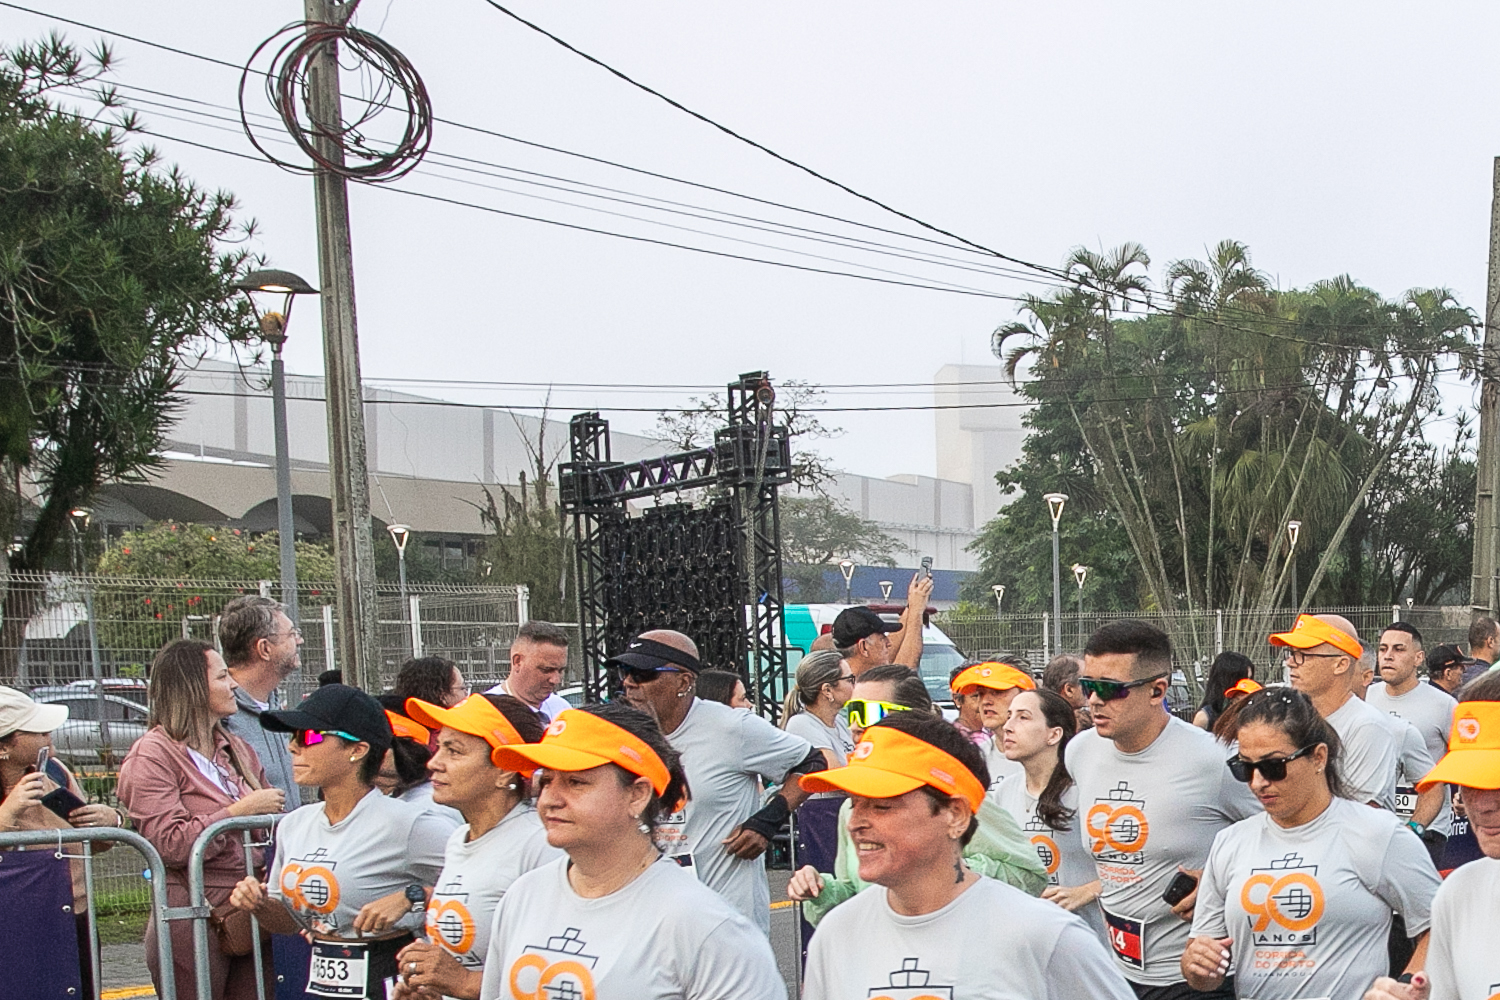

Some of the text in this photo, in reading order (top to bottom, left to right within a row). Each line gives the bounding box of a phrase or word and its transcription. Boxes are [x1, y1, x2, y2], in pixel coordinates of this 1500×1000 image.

[1086, 803, 1149, 854] 90
[280, 863, 341, 914] 90
[1240, 873, 1326, 932] 90
[1258, 934, 1313, 943] ANOS
[1254, 960, 1270, 969] DO
[1255, 951, 1307, 960] CORRIDA
